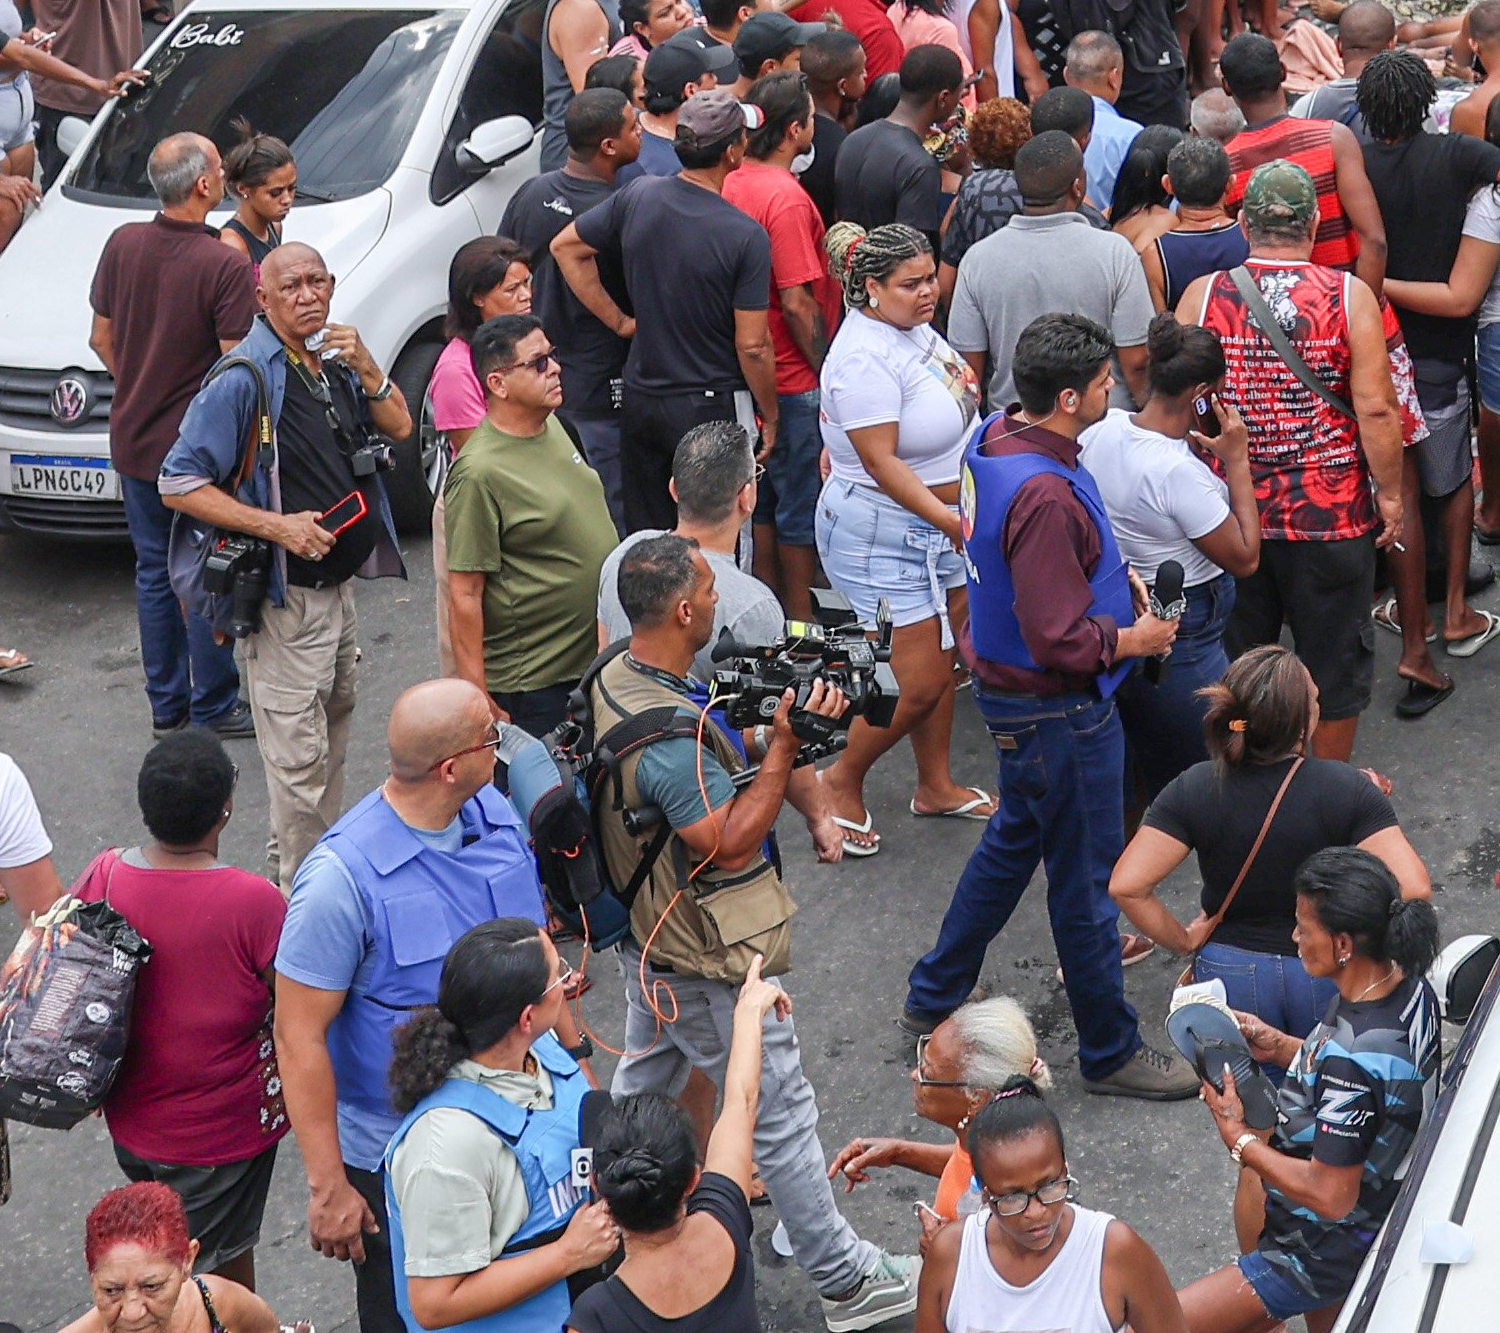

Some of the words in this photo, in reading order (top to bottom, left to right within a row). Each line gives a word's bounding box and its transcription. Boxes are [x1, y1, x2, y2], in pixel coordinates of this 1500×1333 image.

[1220, 334, 1260, 346] andarei
[1243, 348, 1254, 356] as
[1242, 360, 1261, 372] que
[1240, 370, 1256, 380] pés
[1259, 370, 1278, 380] não
[1240, 380, 1267, 389] mãos
[1268, 381, 1288, 389] não
[1244, 390, 1273, 400] olhos
[1274, 390, 1294, 400] não
[1255, 403, 1271, 411] em
[1265, 423, 1277, 432] de
[1279, 421, 1303, 431] fogo
[1259, 432, 1278, 442] não
[1256, 444, 1289, 455] lanças
[19, 467, 106, 494] LPN6C49
